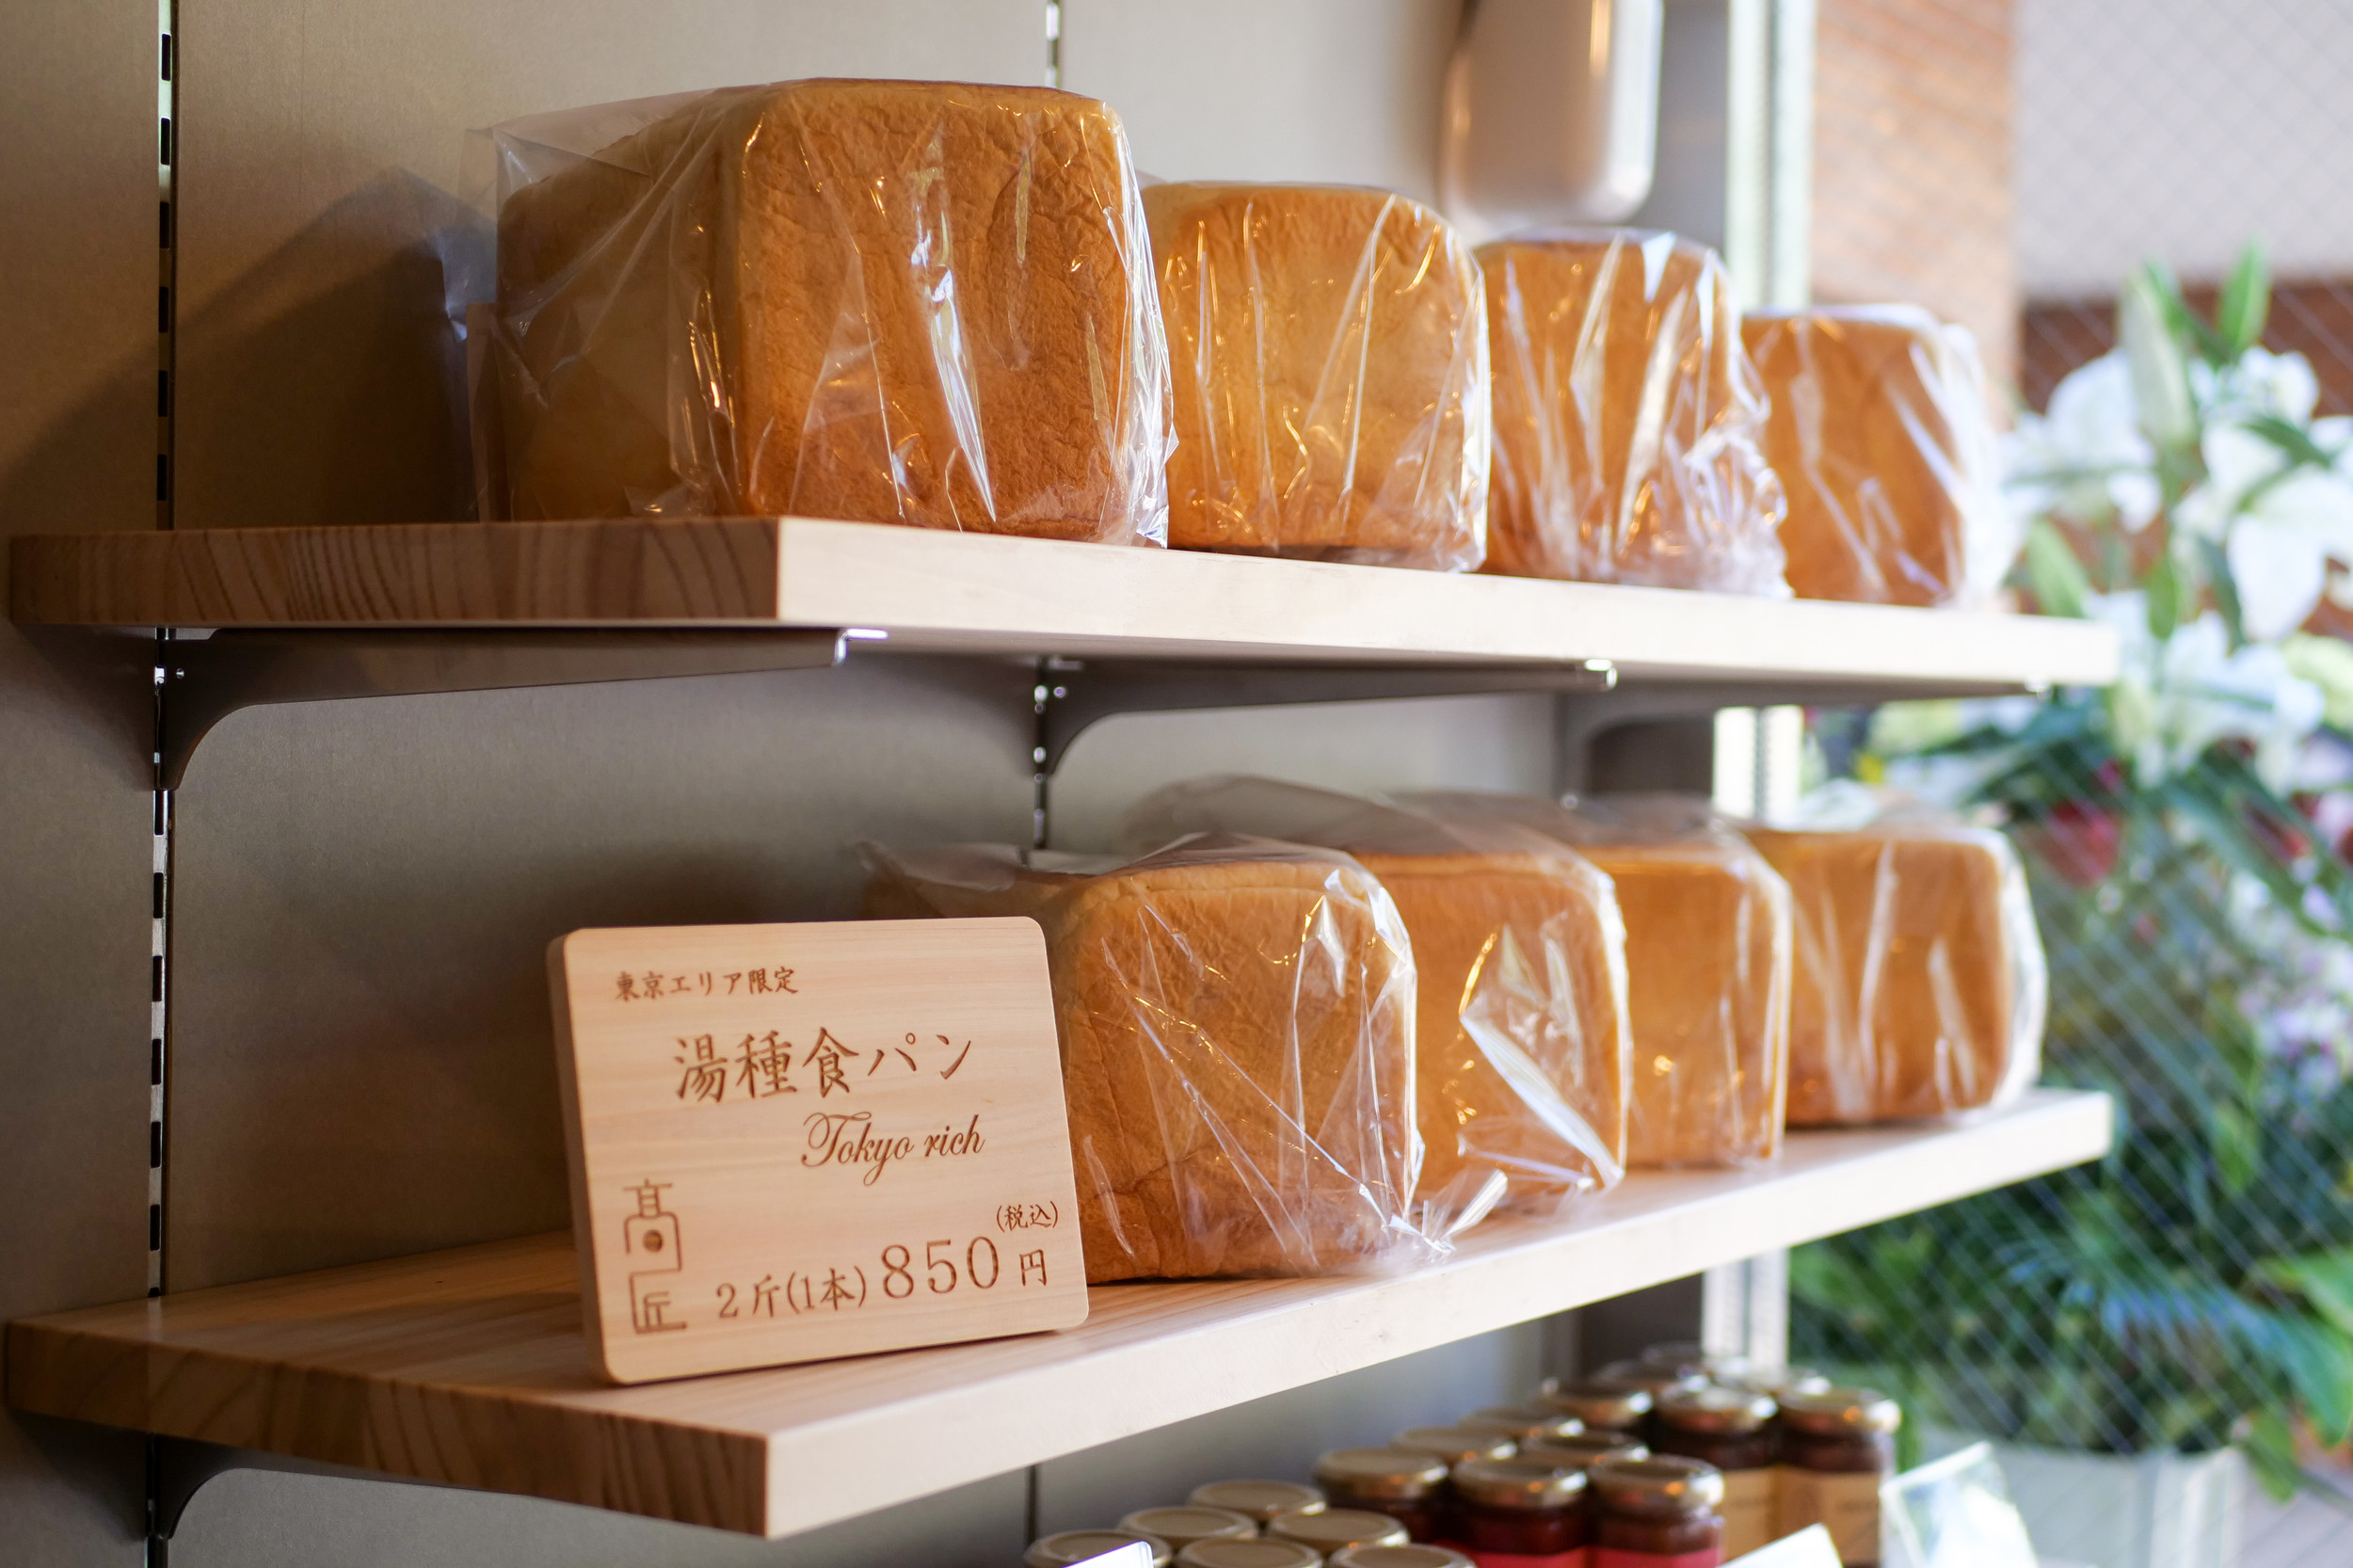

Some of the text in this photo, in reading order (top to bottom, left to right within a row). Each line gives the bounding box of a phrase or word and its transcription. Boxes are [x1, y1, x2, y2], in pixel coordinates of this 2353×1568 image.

[615, 966, 798, 1001] 東京エリア限定
[673, 1027, 971, 1103] 湯種食パン
[801, 1111, 984, 1186] Tokyo rich
[996, 1201, 1059, 1233] (税込)
